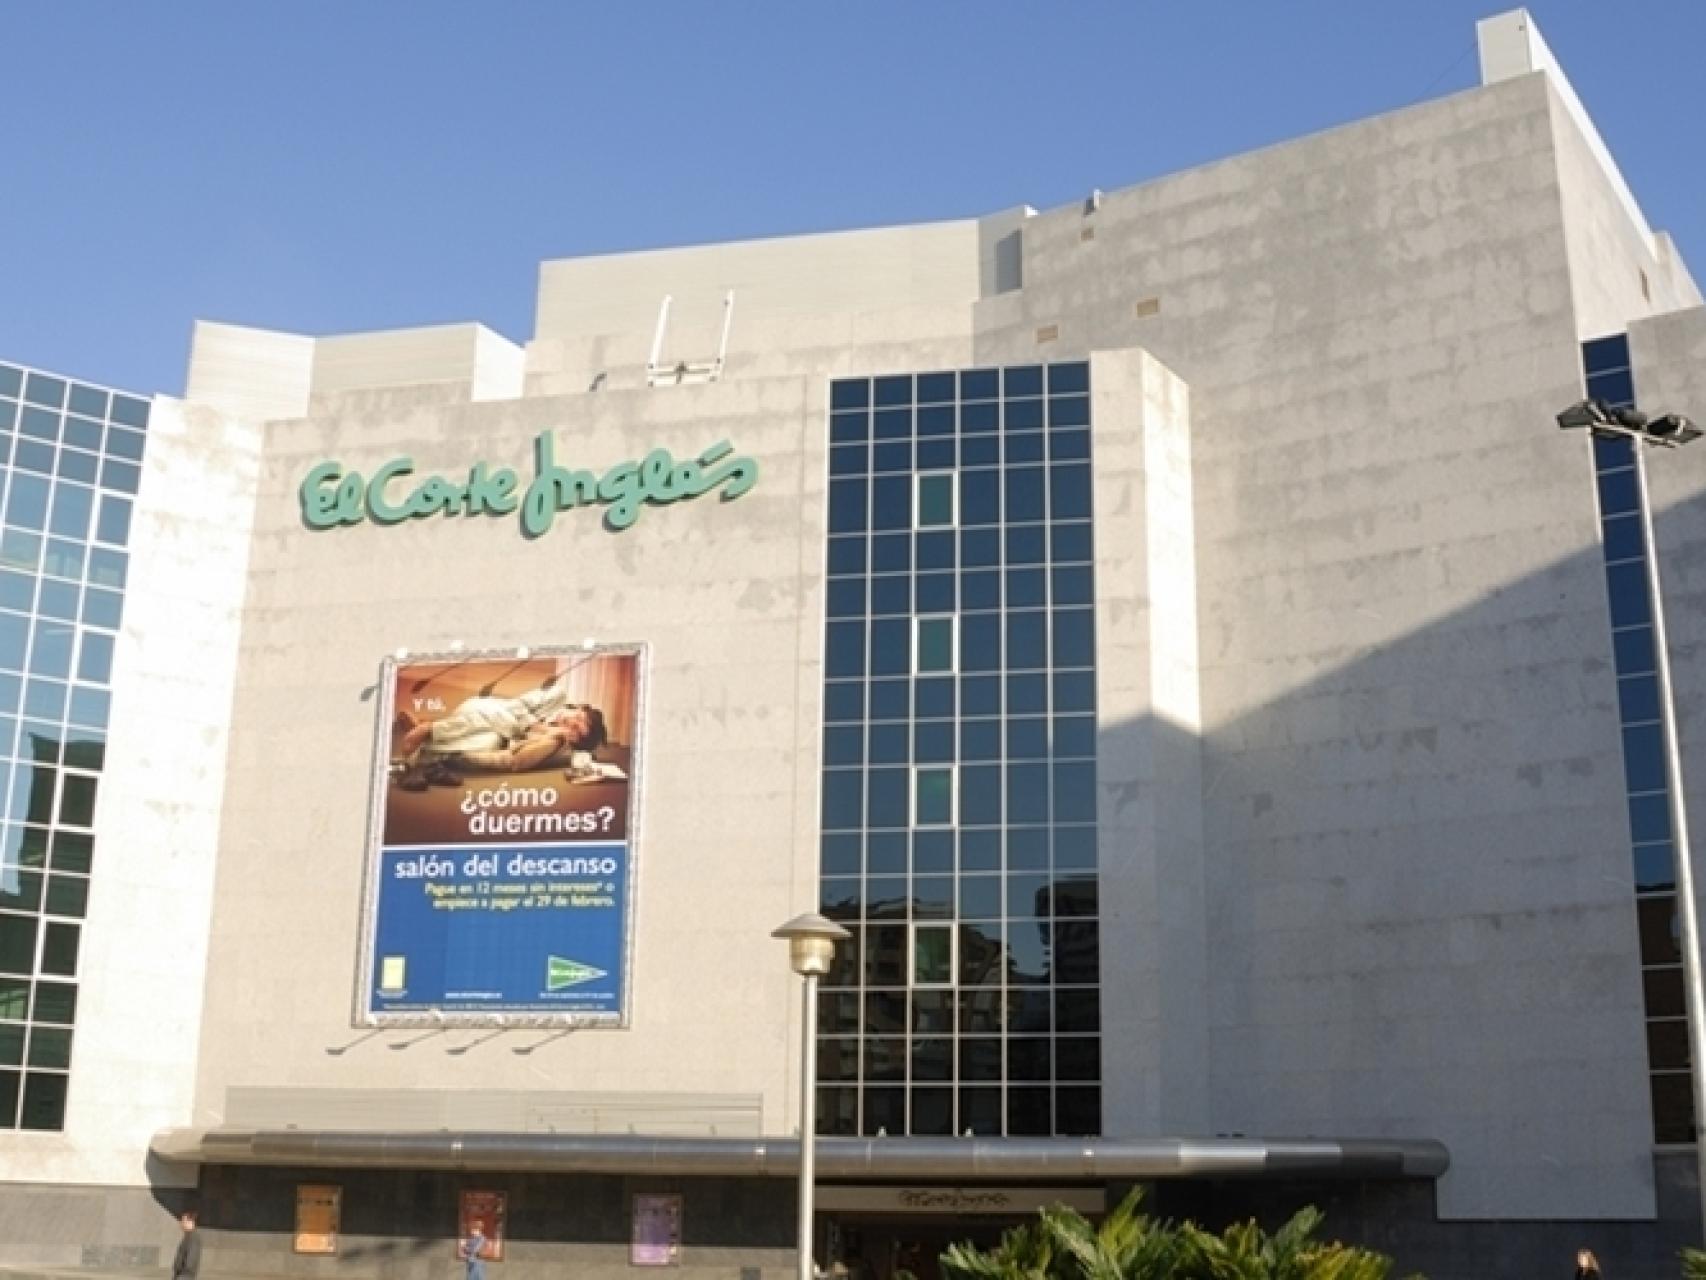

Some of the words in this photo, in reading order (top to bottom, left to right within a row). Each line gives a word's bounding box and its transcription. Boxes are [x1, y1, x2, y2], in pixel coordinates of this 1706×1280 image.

[300, 457, 365, 530] El
[367, 457, 518, 525] Corte
[521, 430, 759, 540] Inglés
[461, 783, 559, 814] ¿cómo
[468, 806, 616, 835] duermes?
[394, 854, 455, 879] salón
[463, 853, 499, 876] del
[506, 852, 617, 876] descanso
